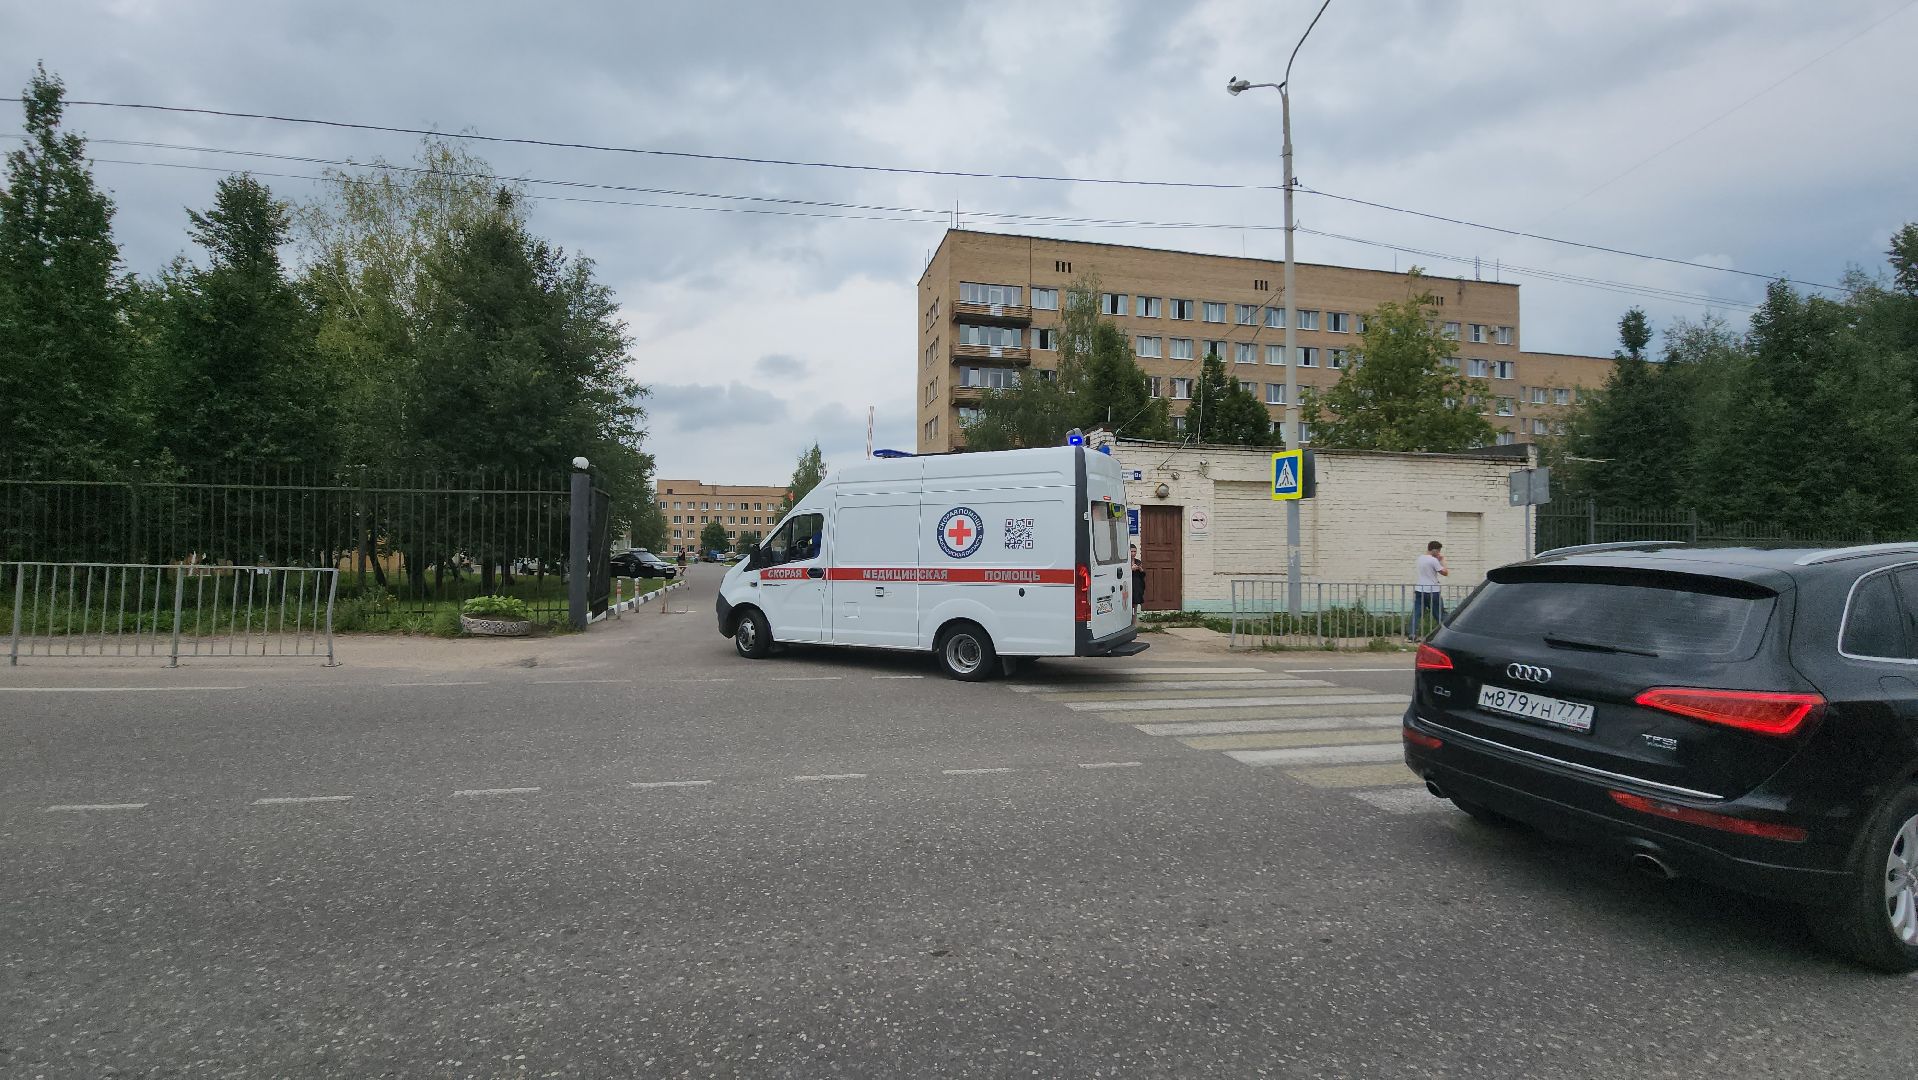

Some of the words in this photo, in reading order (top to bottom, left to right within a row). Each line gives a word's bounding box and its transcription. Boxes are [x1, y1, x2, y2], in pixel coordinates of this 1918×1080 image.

[939, 509, 958, 531] СКОРАЯ
[958, 508, 983, 531] ПОМОЩЬ
[767, 569, 803, 579] СКОРАЯ
[862, 569, 948, 581] МЕДИЦИНСКАЯ
[984, 569, 1041, 582] ПОМОЩЬ
